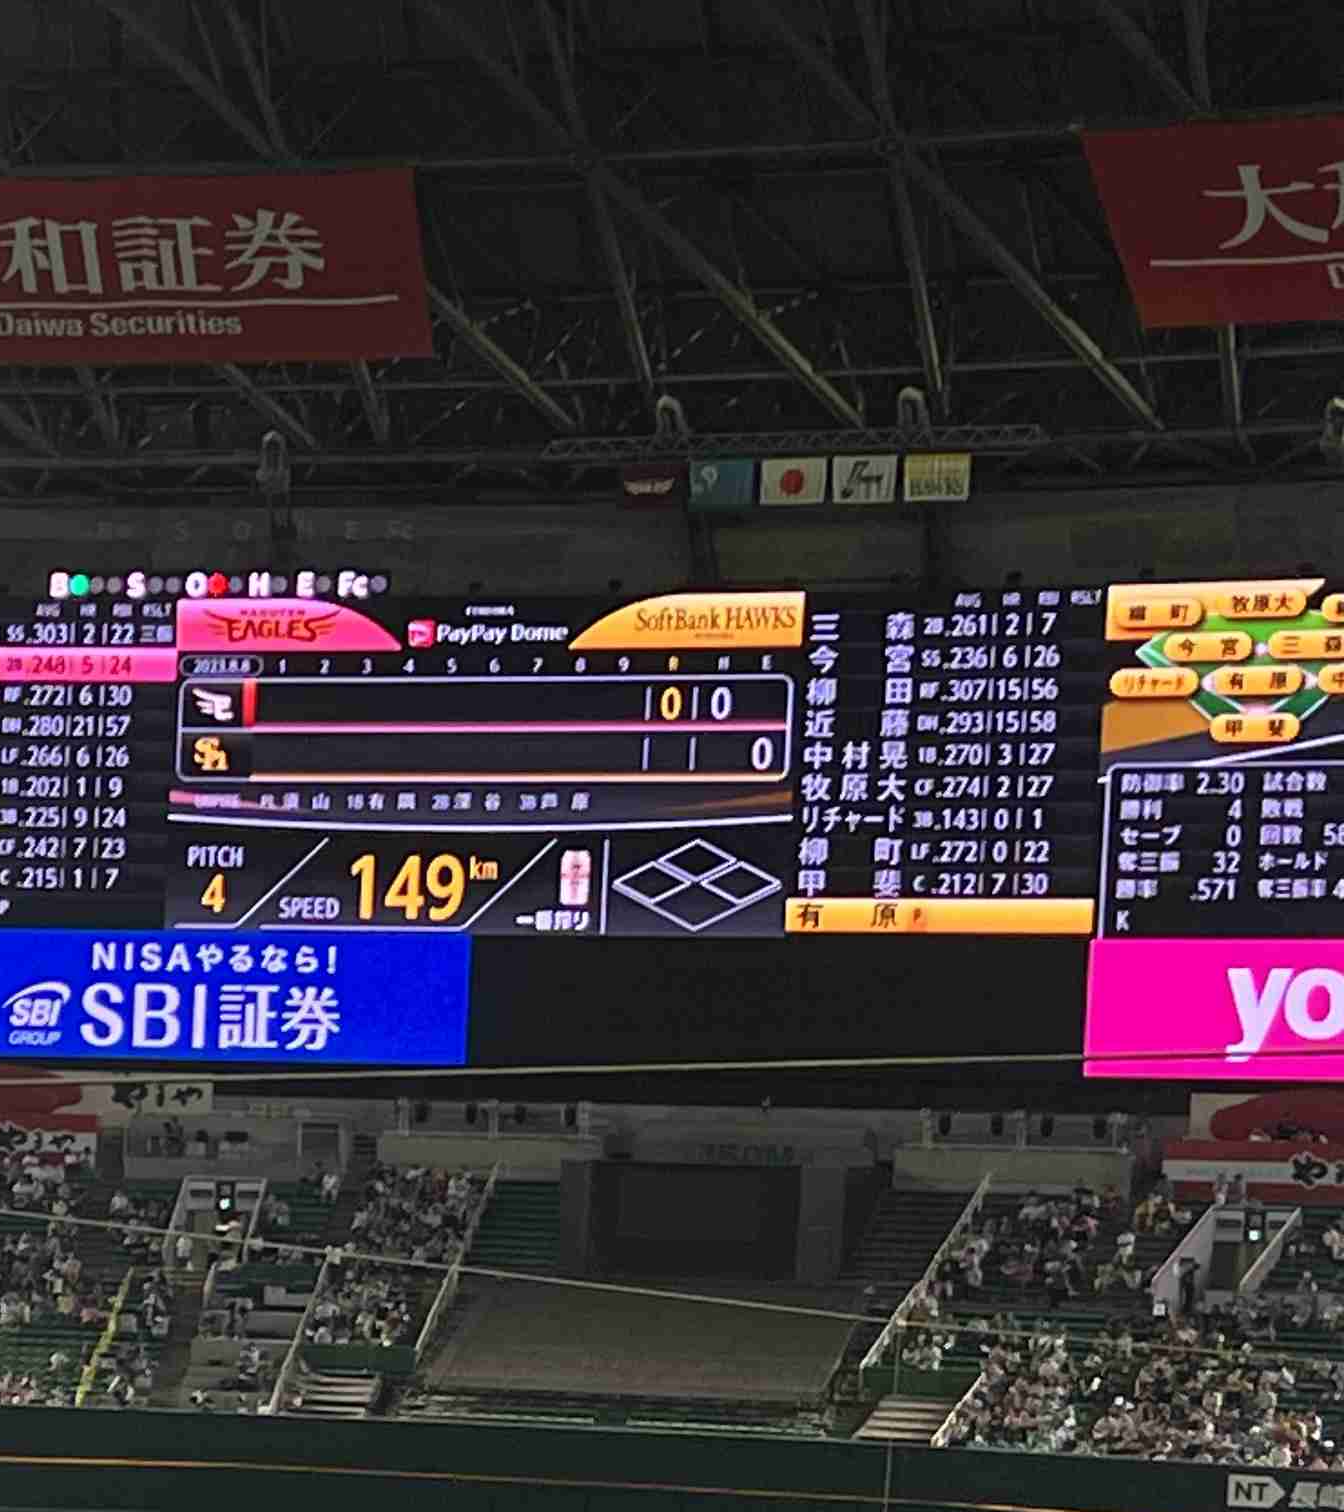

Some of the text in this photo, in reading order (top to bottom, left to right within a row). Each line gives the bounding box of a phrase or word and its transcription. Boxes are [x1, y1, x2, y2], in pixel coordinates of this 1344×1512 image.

[89, 310, 243, 338] Securities
[125, 571, 146, 598] S
[185, 571, 209, 598] O
[248, 571, 271, 598] H
[296, 570, 315, 598] E
[337, 570, 369, 598] Fc
[635, 604, 797, 632] SoftBank HAWKS
[944, 614, 988, 637] .261
[26, 623, 69, 644] .303
[110, 624, 134, 644] 22
[226, 617, 317, 643] EAGLES
[436, 623, 569, 646] PayPay Dome
[25, 656, 65, 675] .248
[109, 657, 132, 675] 24
[808, 644, 1061, 674] 今宮 .236 26
[23, 685, 65, 706] .272
[107, 685, 133, 706] 30
[940, 680, 986, 702] .307
[996, 679, 1022, 701] 15
[1031, 678, 1059, 701] 56
[660, 686, 733, 721] 0 0
[22, 716, 65, 737] .280
[72, 716, 95, 736] 21
[104, 715, 131, 737] 57
[939, 712, 985, 734] .293
[995, 711, 1021, 733] 15
[1029, 710, 1057, 733] 58
[20, 746, 63, 767] .266
[104, 746, 130, 767] 26
[751, 736, 774, 771] 0
[803, 741, 1056, 770] 中村晃 .270 27
[19, 776, 61, 798] .202
[801, 773, 1054, 802] 牧原大 .274 27
[1195, 772, 1246, 795] 2.30
[18, 806, 61, 828] .225
[101, 807, 127, 828] 24
[802, 806, 979, 833] リチャード .143
[1227, 798, 1242, 820] 4
[1226, 824, 1242, 847] 0
[16, 837, 60, 859] .242
[100, 837, 127, 859] 23
[186, 845, 244, 868] PITCH
[932, 841, 979, 863] .272
[1023, 840, 1050, 863] 22
[1213, 850, 1328, 873] 32 ホールド
[16, 867, 59, 889] .215
[278, 852, 499, 922] SPEED 149 km
[931, 873, 978, 895] .212
[1021, 873, 1049, 895] 30
[1189, 877, 1236, 901] .571
[200, 872, 226, 914] 4
[797, 902, 900, 929] 有原
[1115, 910, 1130, 931] K
[91, 942, 339, 974] NISAやるなら!
[8, 997, 62, 1028] SBI
[80, 982, 342, 1051] SBI証券
[8, 1030, 62, 1046] GROUP
[1234, 1481, 1270, 1502] NT
